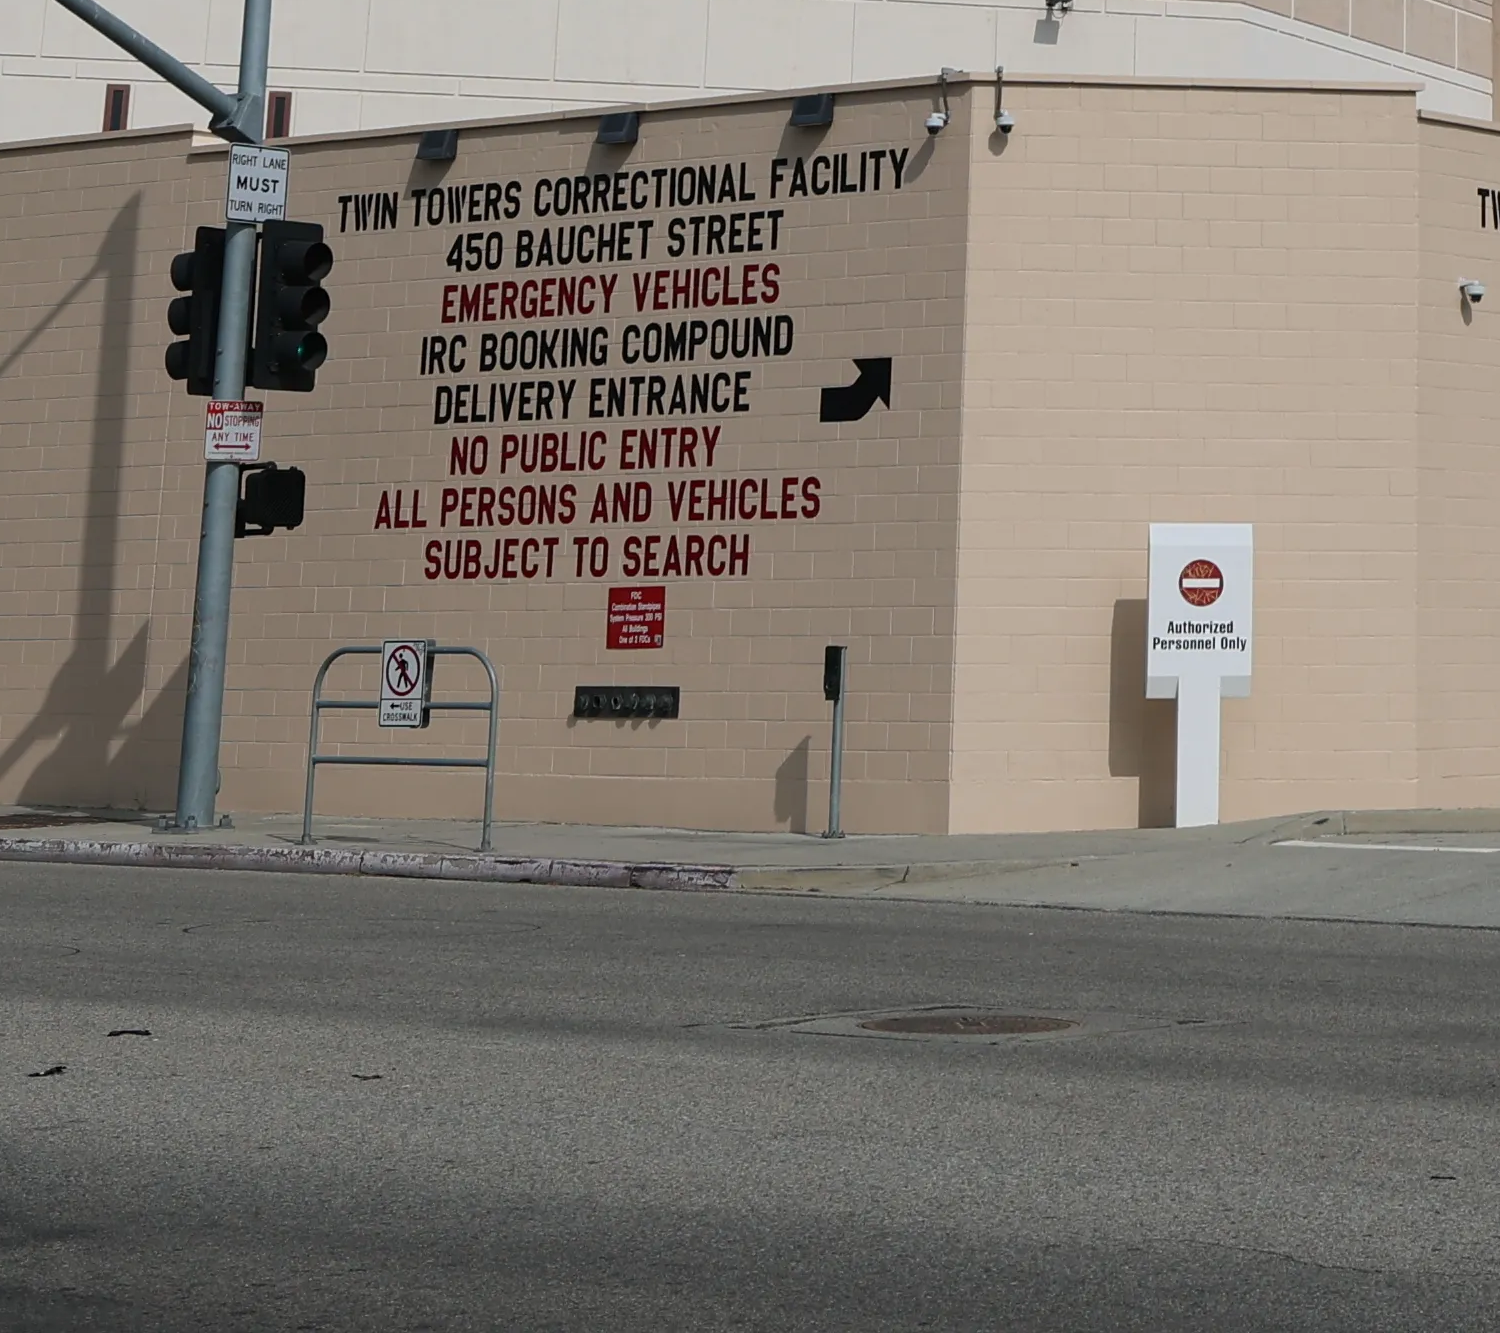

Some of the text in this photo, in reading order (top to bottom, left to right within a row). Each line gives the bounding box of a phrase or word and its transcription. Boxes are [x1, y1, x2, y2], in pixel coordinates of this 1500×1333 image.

[232, 153, 287, 170] RIGHT LANE
[236, 175, 279, 193] MUST
[338, 148, 909, 233] TWIN TOWERS CORRECTIONAL FACILITY
[230, 199, 283, 215] TURN RIGHT
[446, 210, 784, 272] 450 BAUCHET STREET
[441, 263, 780, 323] EMERGENCY VEHICLES
[420, 315, 793, 375] IRC BOOKING COMPOUND
[434, 371, 751, 424] DELIVERY ENTRANCE
[210, 402, 260, 411] TOW-AWAY
[207, 413, 260, 428] NO STOPPING
[212, 432, 254, 442] ANY TIME
[450, 426, 721, 475] NO PUBLIC ENTRY
[374, 477, 820, 529] ALL PERSONS AND VEHICLES
[425, 534, 749, 579] SUBJECT TO SEARCH
[1167, 621, 1234, 634] Authorized
[1153, 636, 1247, 652] Personnel Only
[400, 701, 413, 711] USE
[383, 713, 418, 722] CROSSWALK
